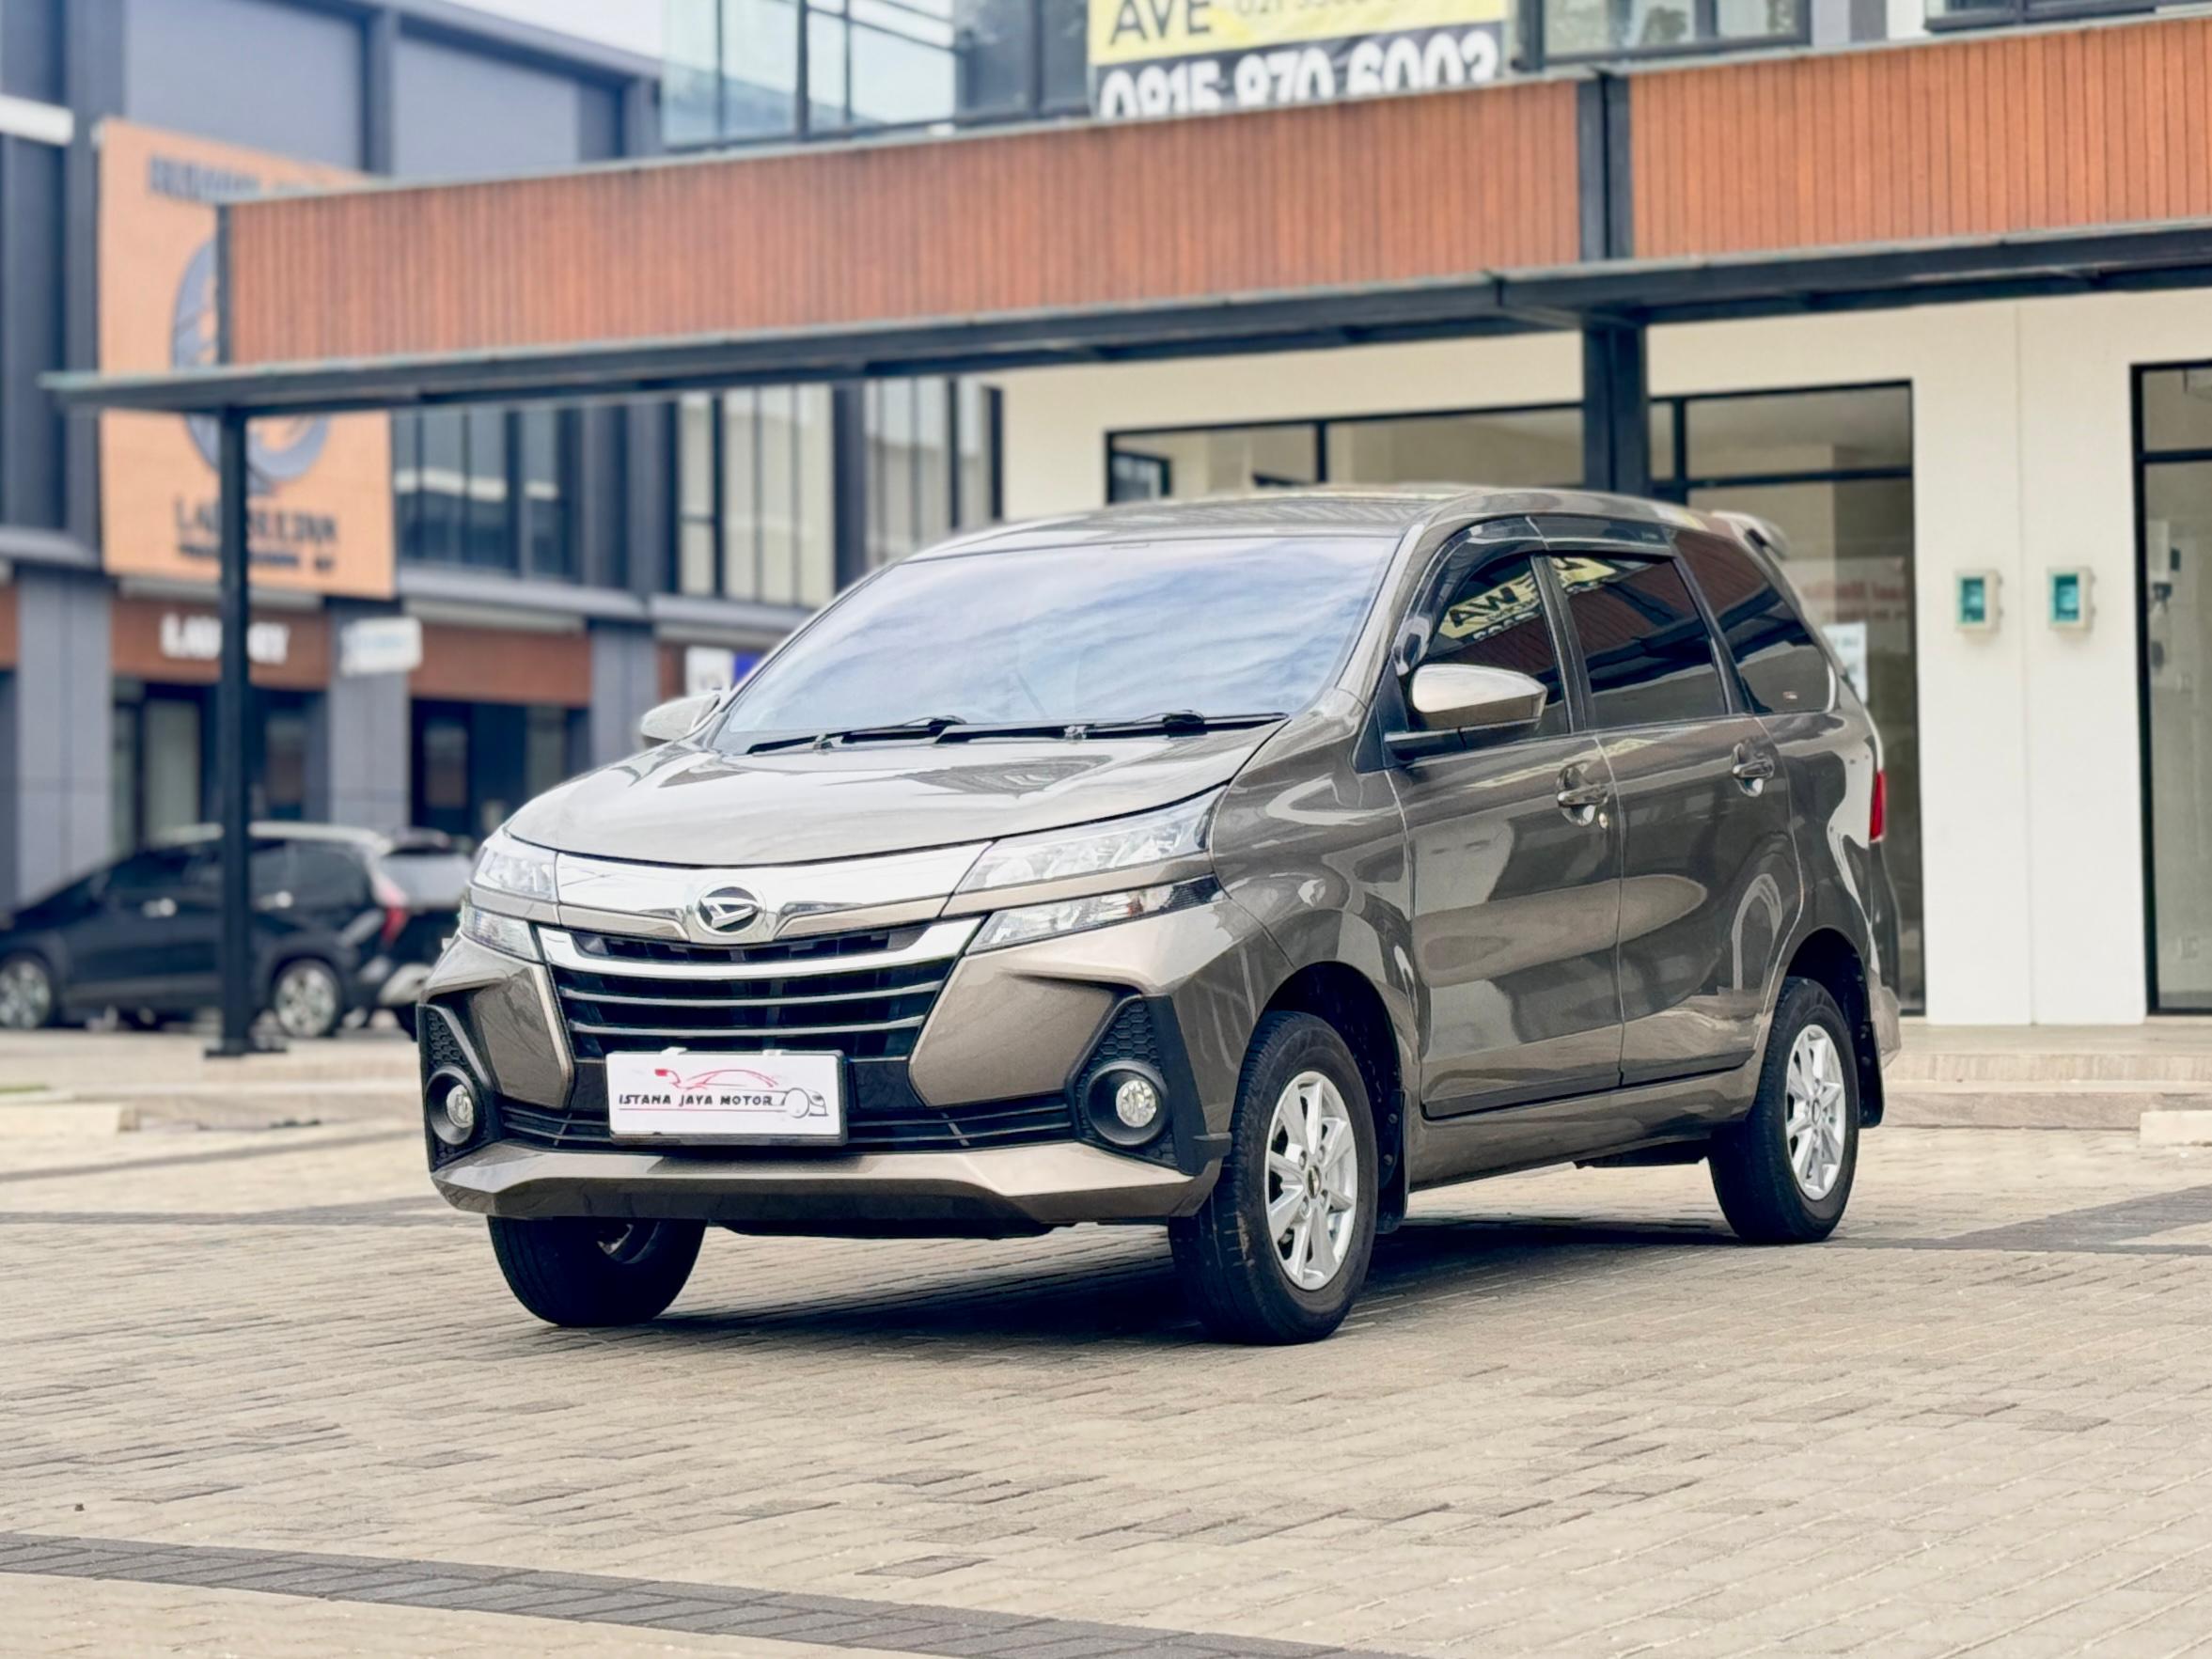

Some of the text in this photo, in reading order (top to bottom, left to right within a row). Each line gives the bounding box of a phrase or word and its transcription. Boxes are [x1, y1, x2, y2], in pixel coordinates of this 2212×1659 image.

[619, 1093, 773, 1107] ISTANA JAYA MOTOR
